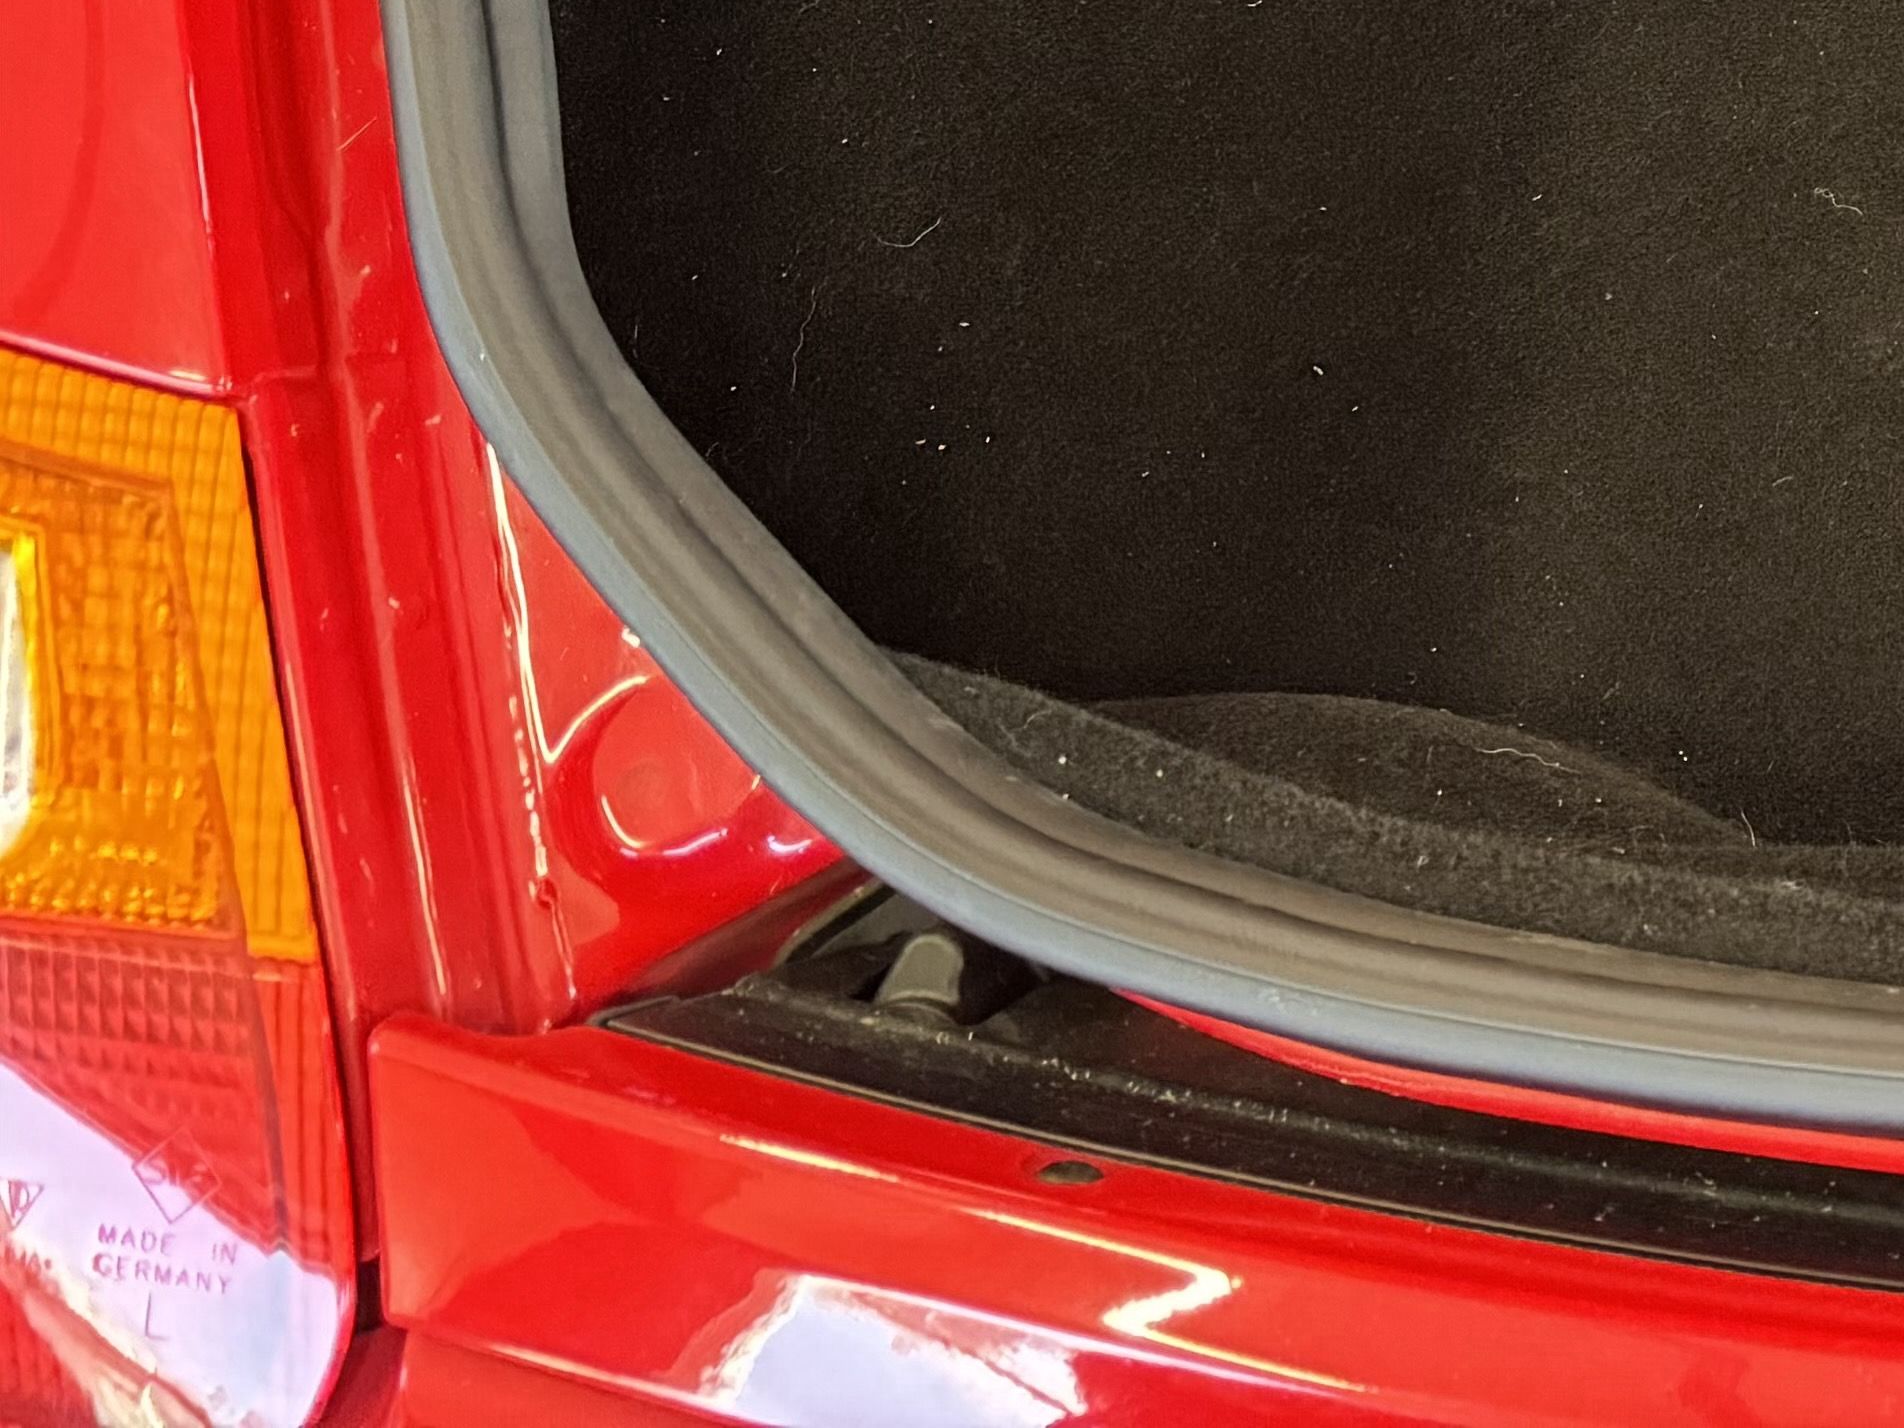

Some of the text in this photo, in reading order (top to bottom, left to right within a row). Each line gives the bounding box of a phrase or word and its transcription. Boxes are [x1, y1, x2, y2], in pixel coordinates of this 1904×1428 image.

[98, 1222, 238, 1265] MADE IN
[92, 1252, 233, 1294] GERMANY
